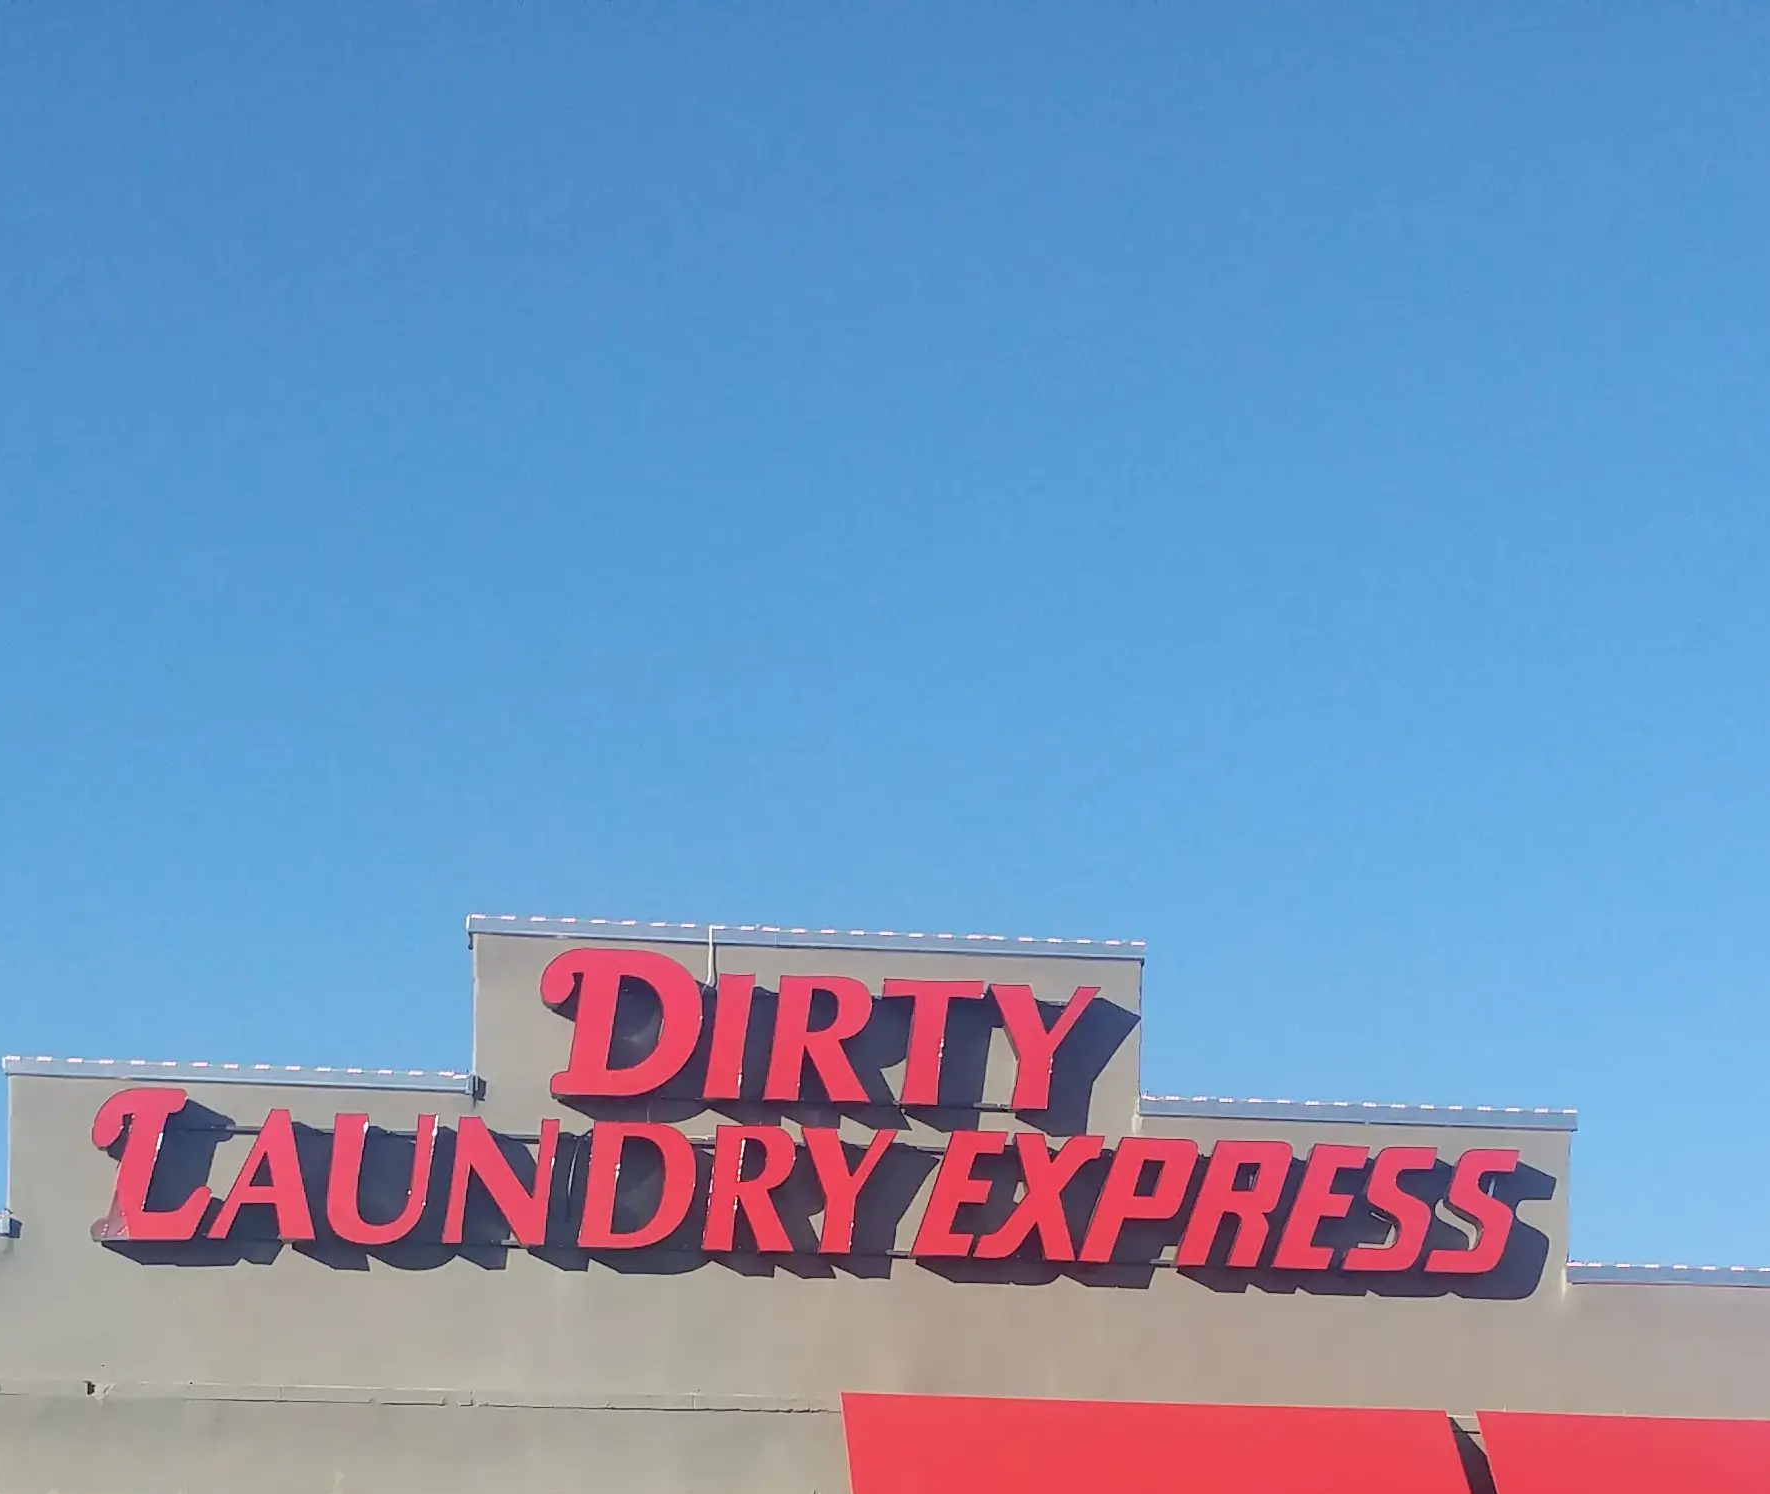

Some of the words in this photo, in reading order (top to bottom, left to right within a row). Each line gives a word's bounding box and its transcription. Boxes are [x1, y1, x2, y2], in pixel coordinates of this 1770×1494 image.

[541, 948, 1098, 1110] DIRTY
[92, 1088, 898, 1255] LAUNDRY
[912, 1129, 1519, 1274] EXPRESS
